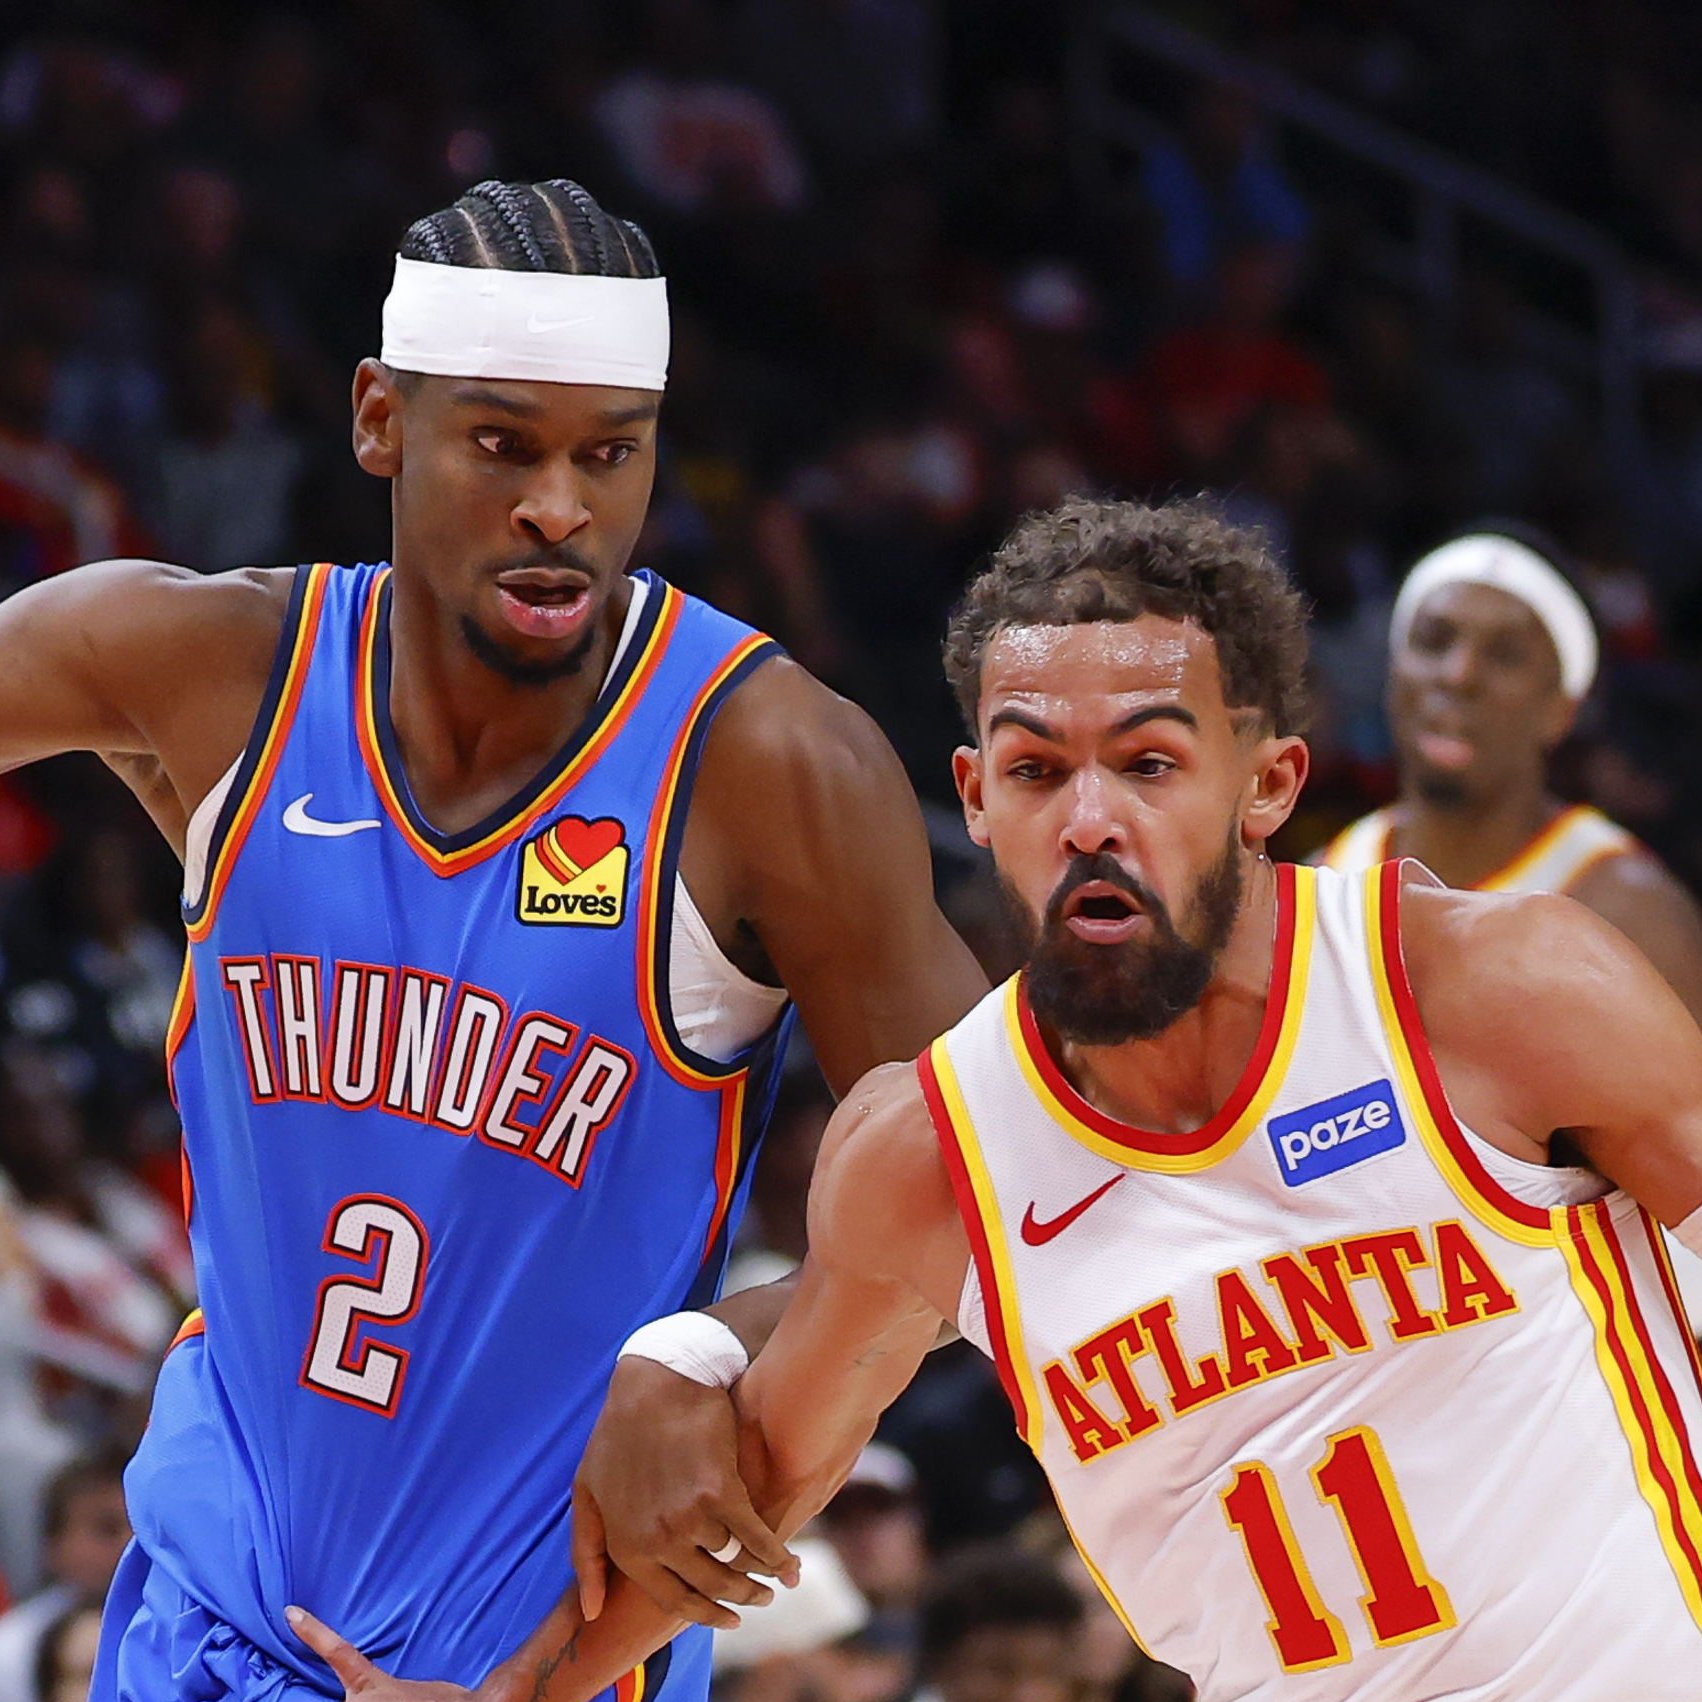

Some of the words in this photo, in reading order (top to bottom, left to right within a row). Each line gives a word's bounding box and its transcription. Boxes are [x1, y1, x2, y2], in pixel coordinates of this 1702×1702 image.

[218, 952, 638, 1190] THUNDER
[1278, 1099, 1392, 1171] paze
[298, 1192, 430, 1419] 2
[1040, 1217, 1521, 1465] ATLANTA
[1218, 1423, 1458, 1674] 11
